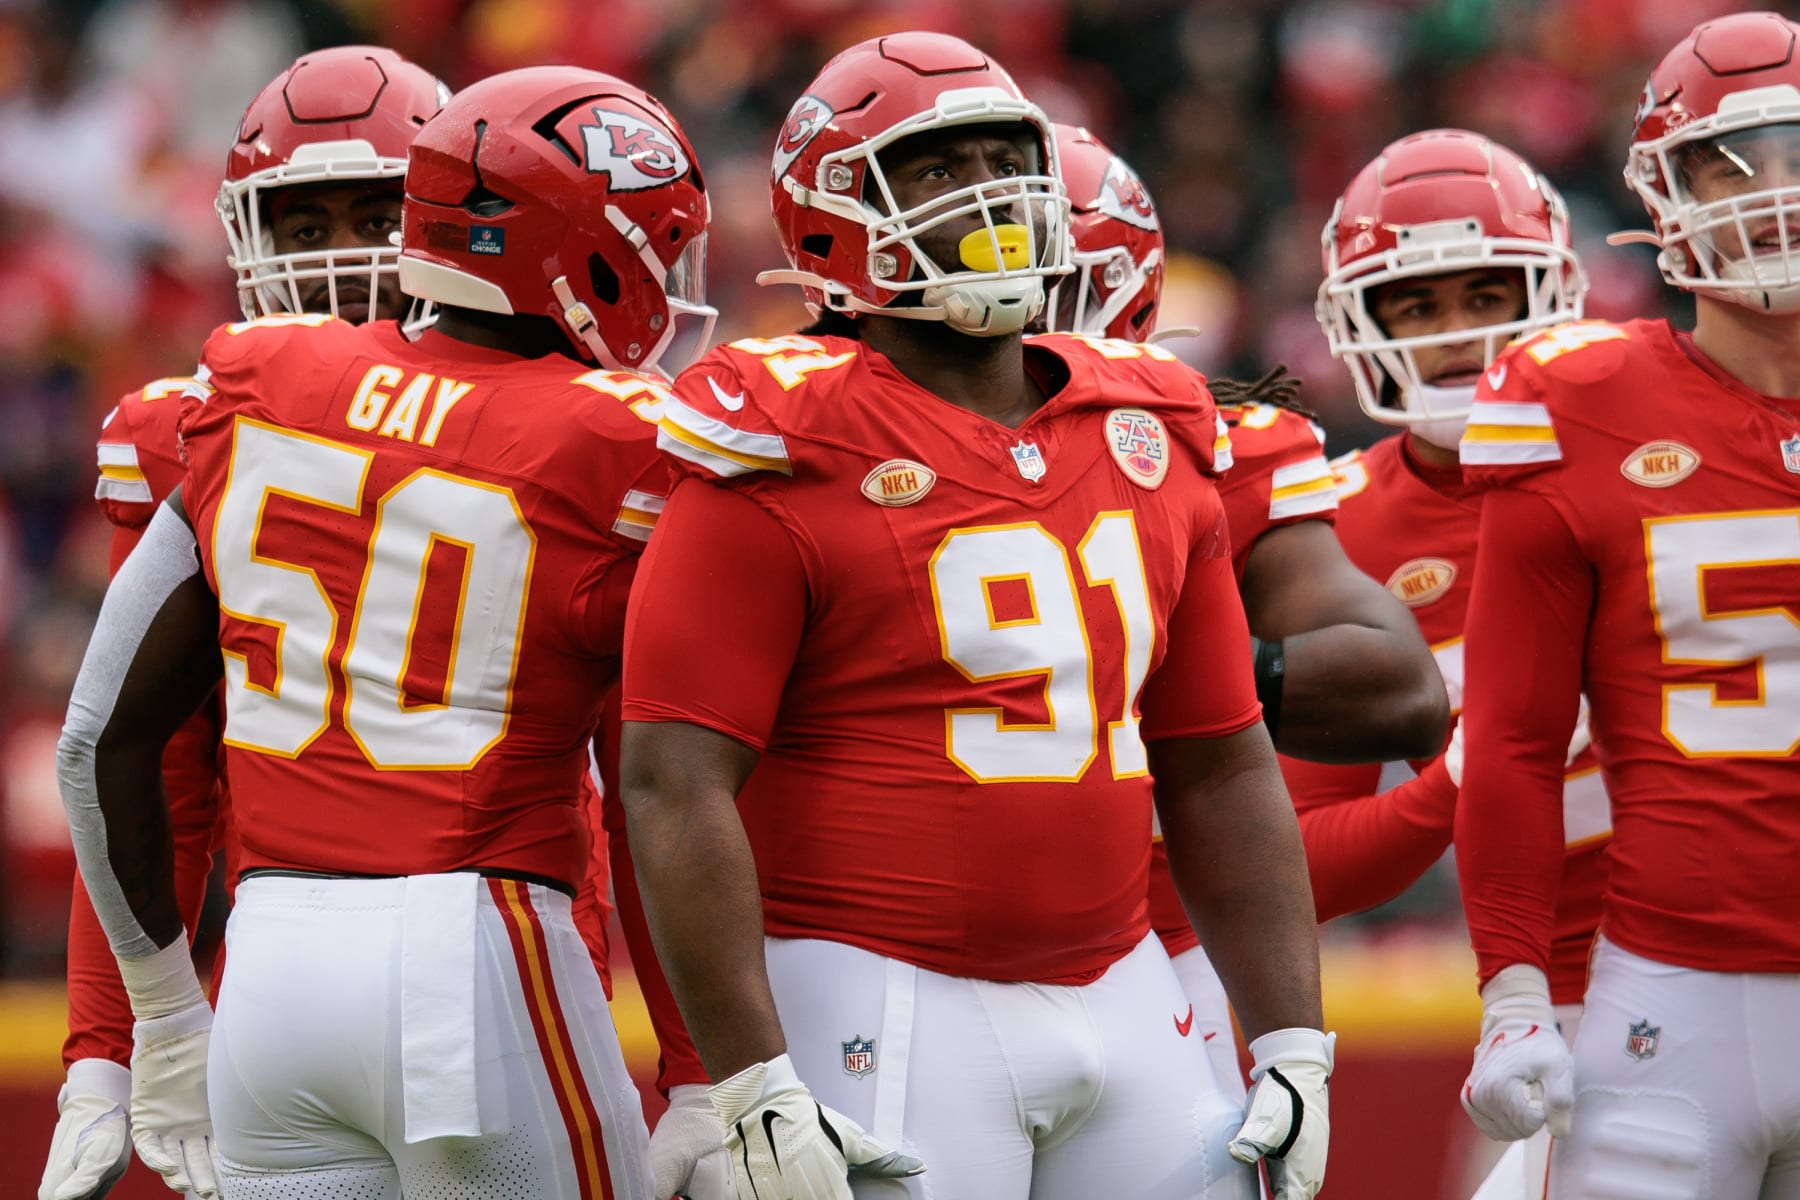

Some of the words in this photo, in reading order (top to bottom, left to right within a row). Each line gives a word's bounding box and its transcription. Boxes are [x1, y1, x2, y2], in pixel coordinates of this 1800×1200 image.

[605, 124, 677, 178] KC
[345, 364, 476, 448] GAY
[1118, 413, 1162, 460] A
[880, 470, 918, 496] NKH
[1642, 452, 1680, 477] NKH
[212, 414, 538, 771] 50
[1401, 569, 1438, 599] NKH
[928, 509, 1155, 784] 91
[847, 1053, 871, 1070] NFL
[1630, 1035, 1654, 1054] NFL
